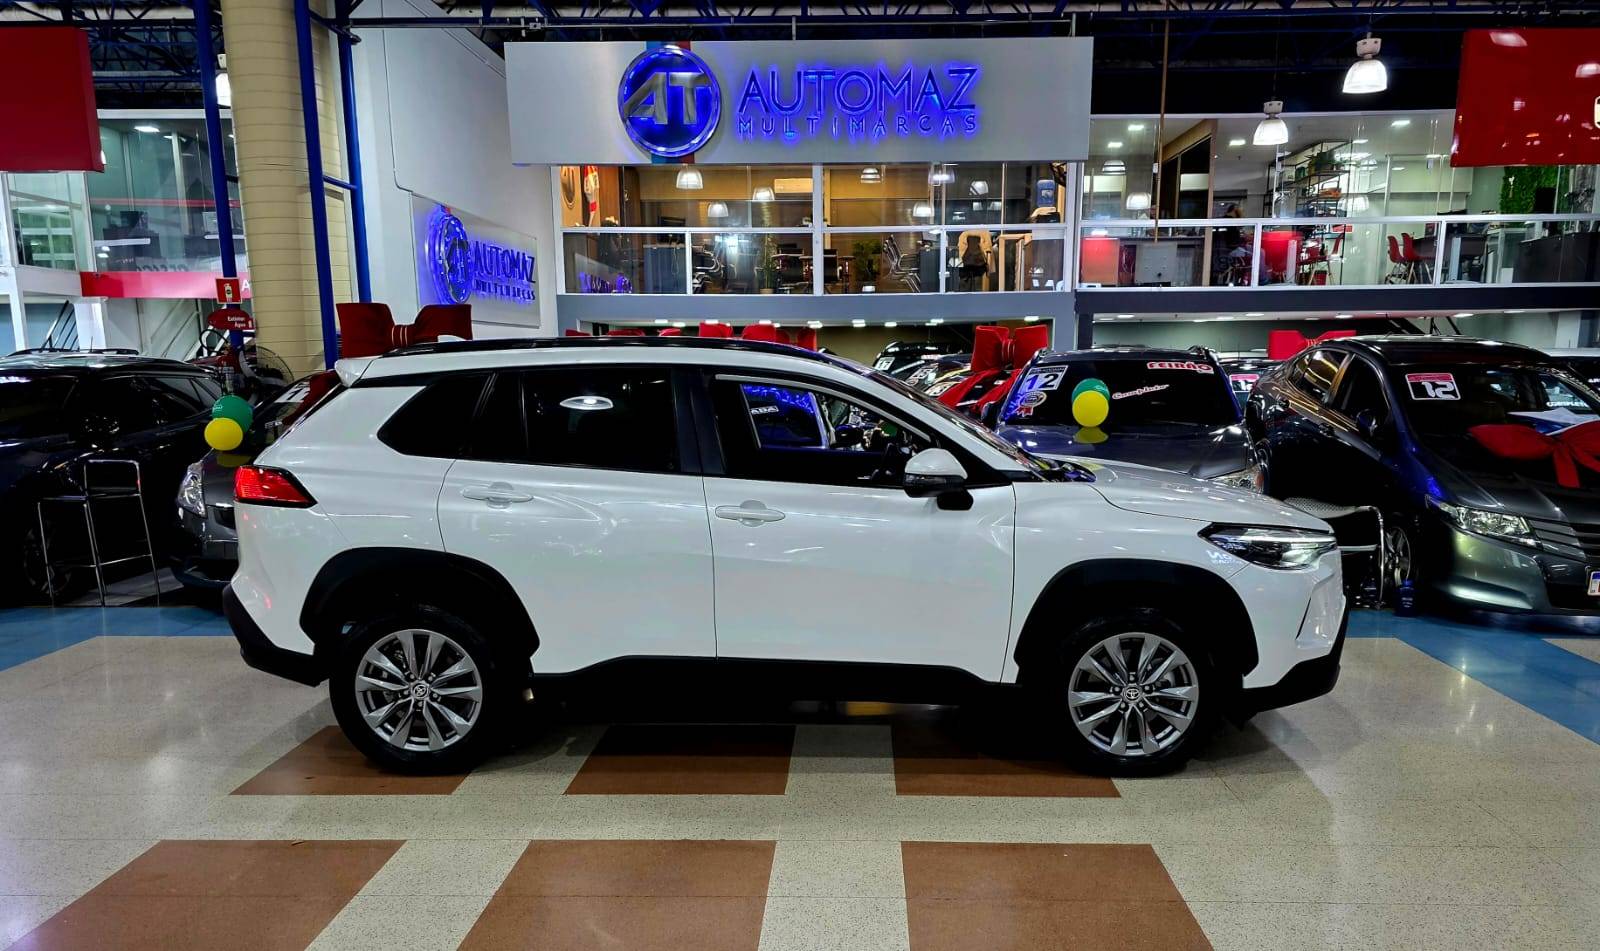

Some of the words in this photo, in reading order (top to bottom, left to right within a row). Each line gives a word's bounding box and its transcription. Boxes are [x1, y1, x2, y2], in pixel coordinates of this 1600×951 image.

[737, 68, 979, 114] AUTOMAZ
[738, 115, 977, 136] MULTIMARCAS
[473, 240, 537, 283] AUTOMAZ
[1025, 373, 1059, 390] 12
[1421, 381, 1455, 399] 12
